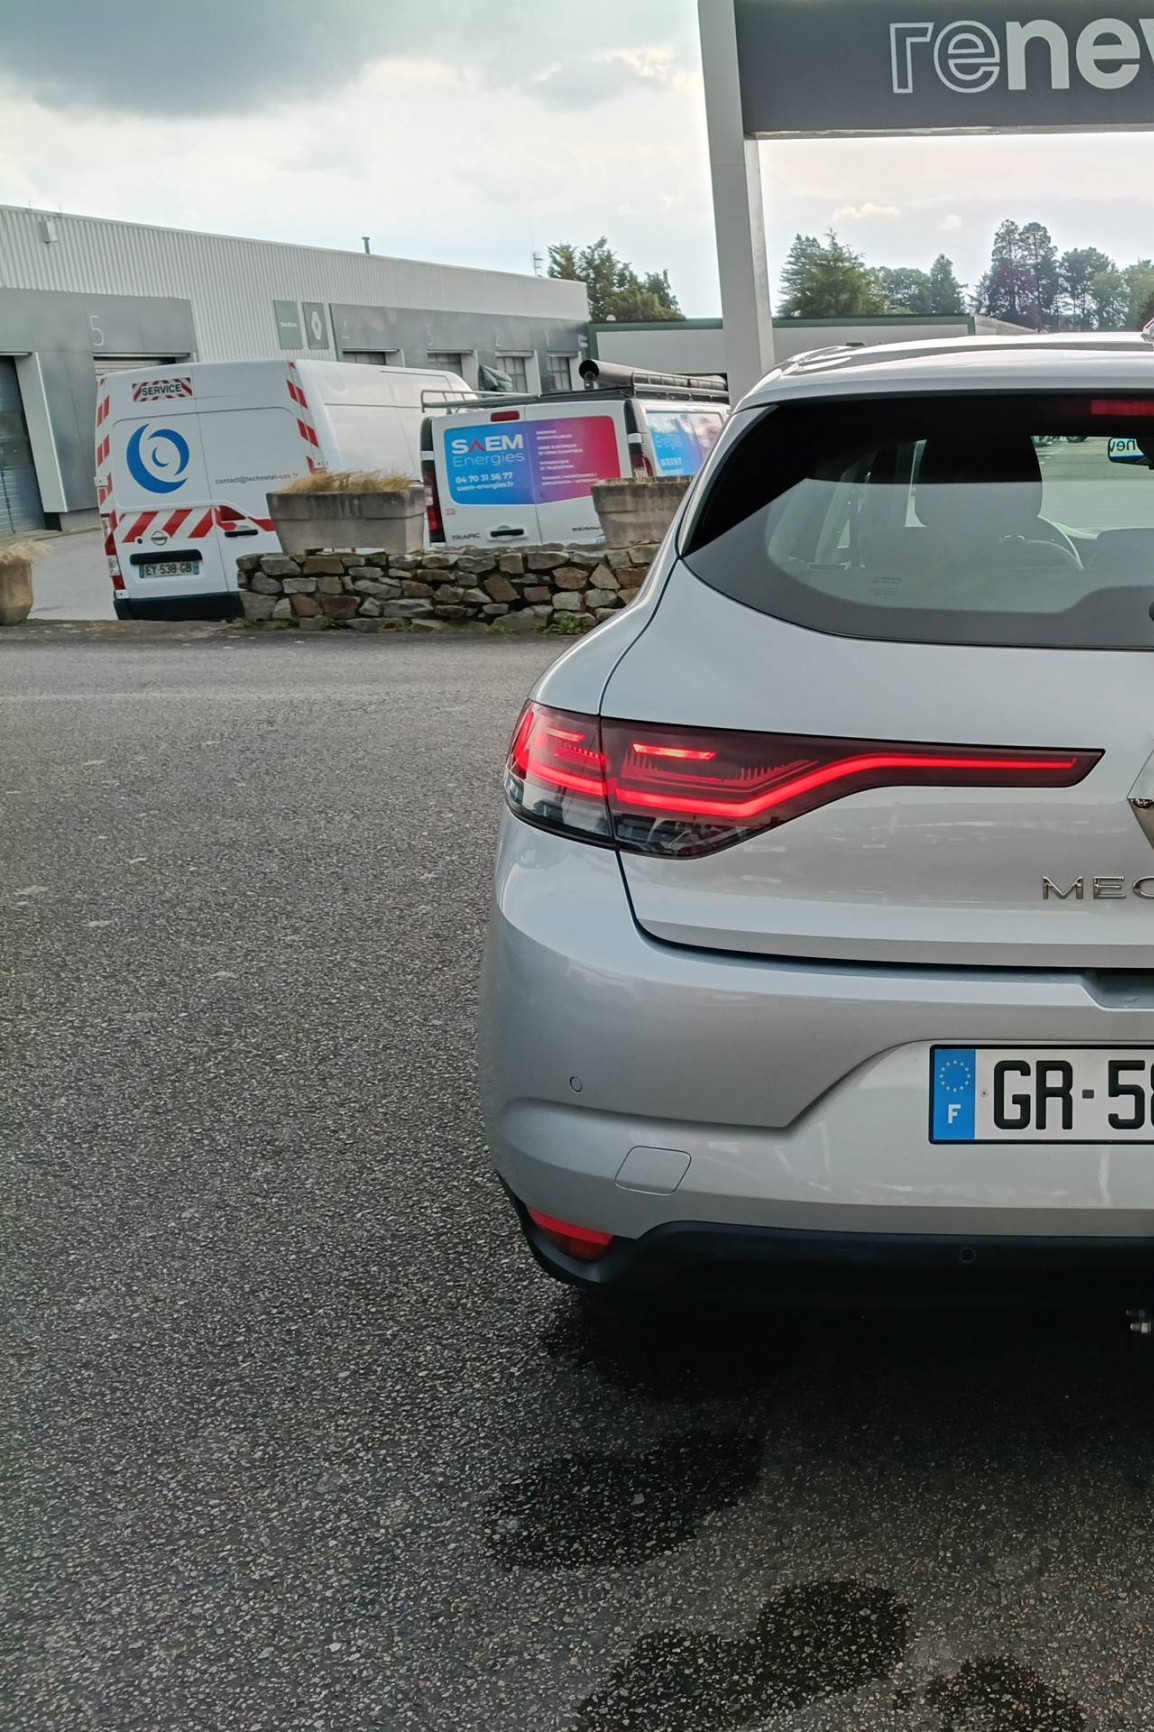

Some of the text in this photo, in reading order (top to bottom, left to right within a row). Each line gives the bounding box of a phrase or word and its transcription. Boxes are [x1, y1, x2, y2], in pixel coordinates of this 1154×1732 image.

[90, 315, 104, 346] 5
[142, 383, 182, 396] SERVICE
[452, 452, 526, 468] Energies
[455, 476, 467, 484] 04
[467, 475, 479, 483] 70
[480, 473, 489, 482] 31
[502, 471, 513, 480] 77
[947, 1103, 962, 1125] F
